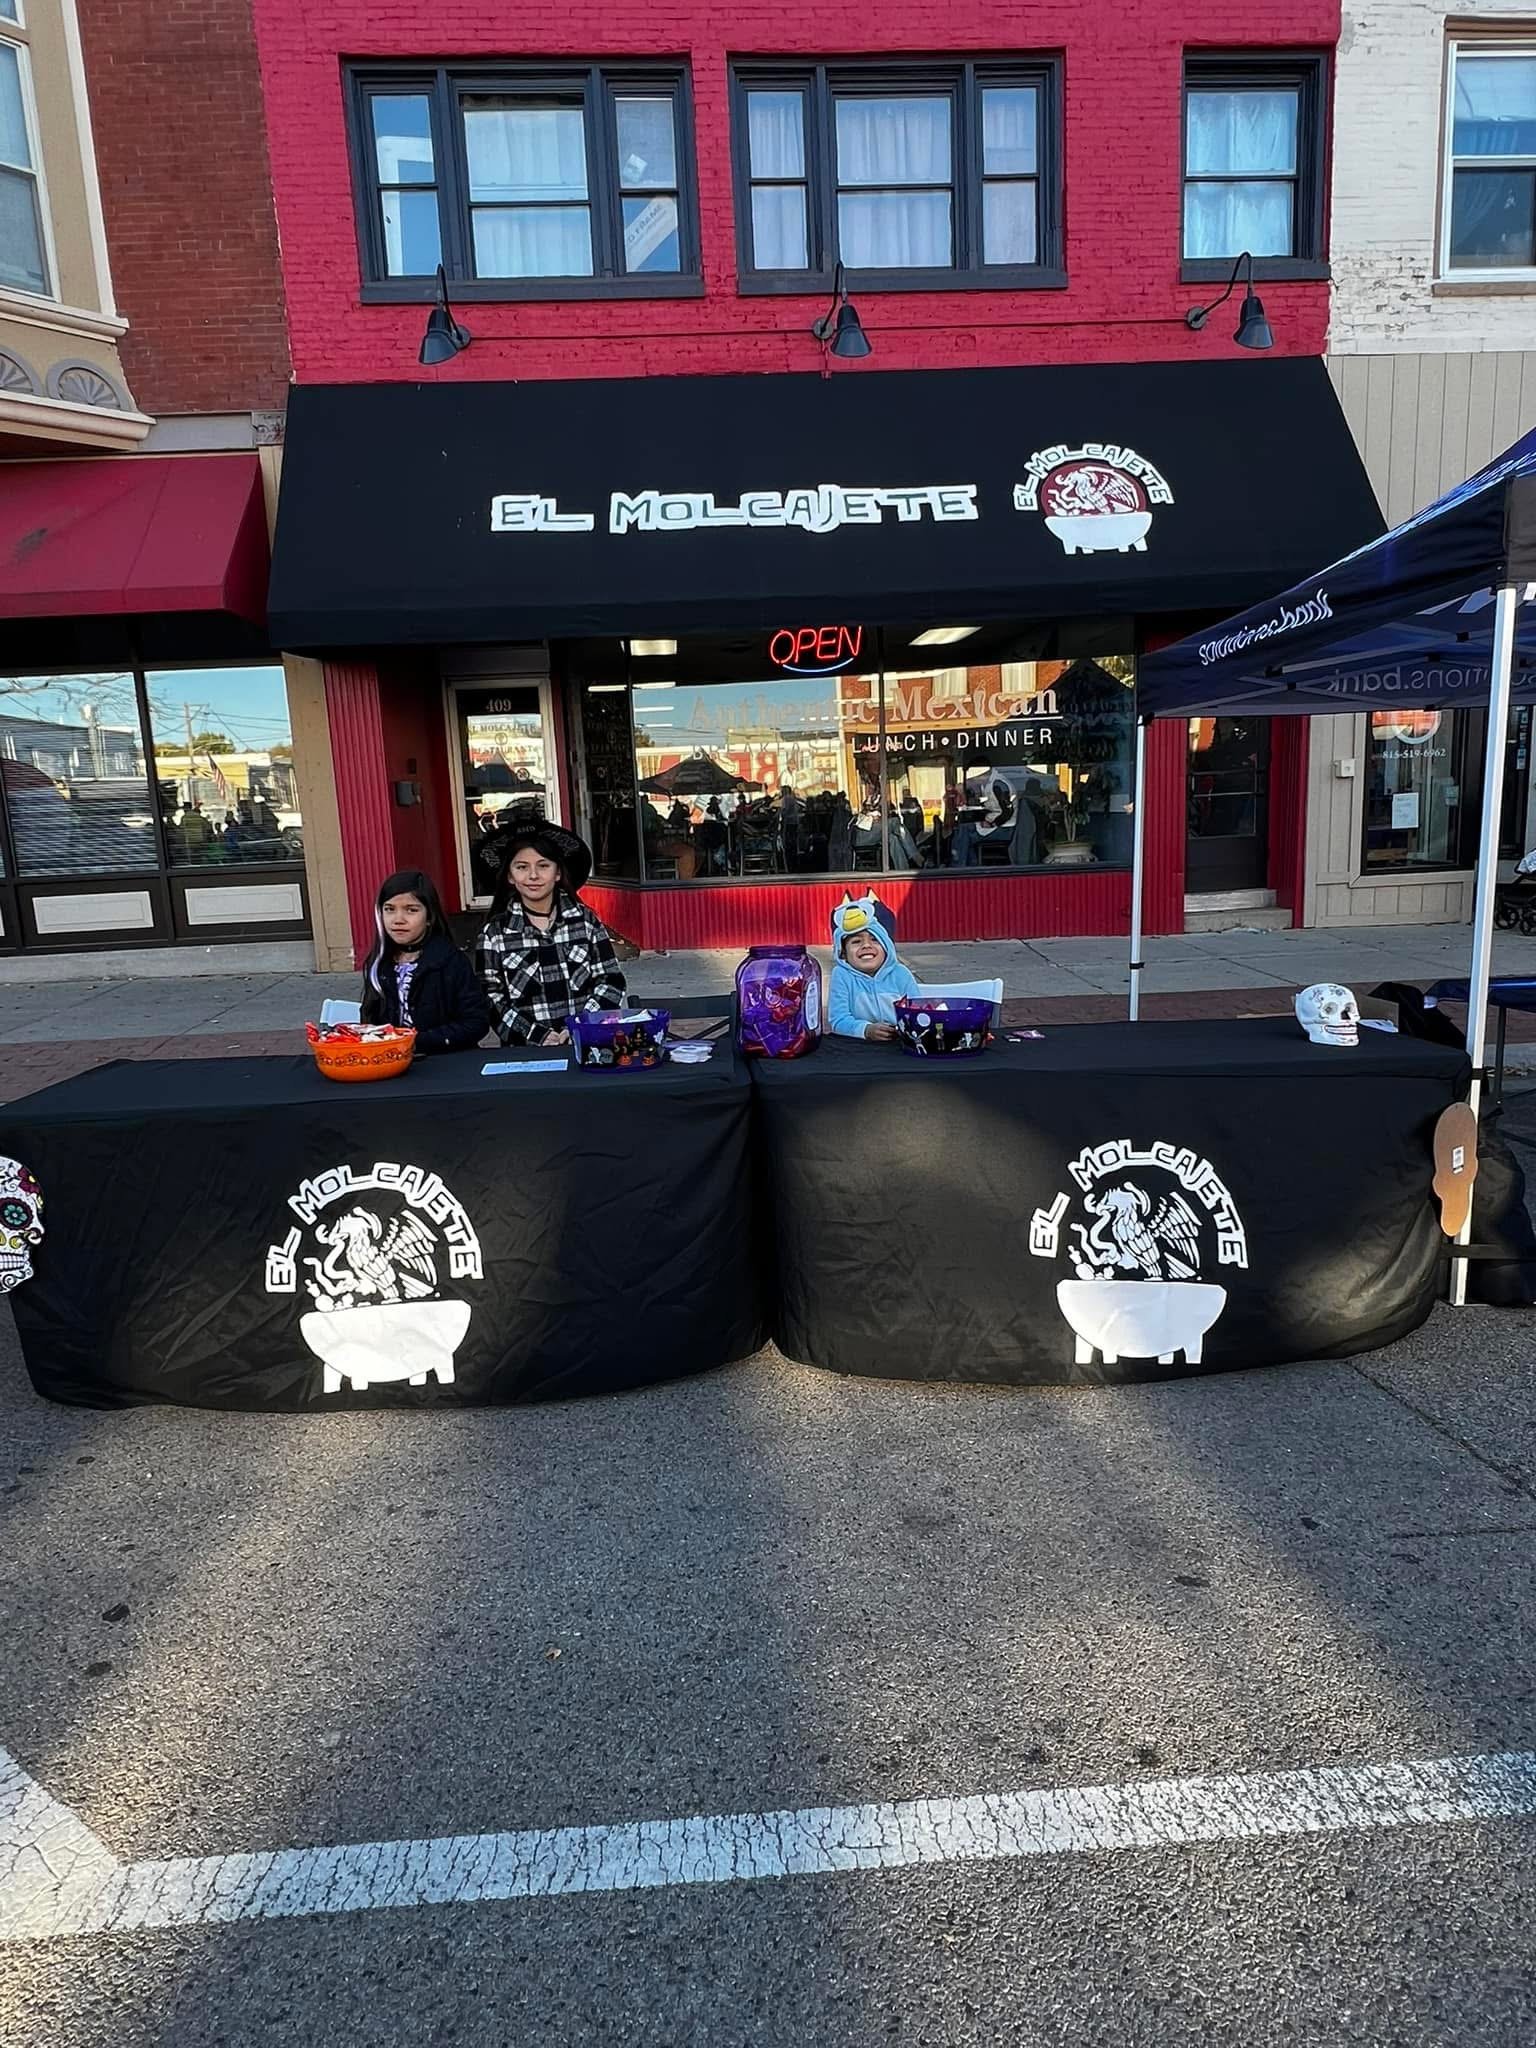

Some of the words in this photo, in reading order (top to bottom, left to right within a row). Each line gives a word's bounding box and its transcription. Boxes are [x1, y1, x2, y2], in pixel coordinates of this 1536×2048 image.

[1013, 474, 1040, 511] EL
[1024, 443, 1175, 504] MOLCAJETE
[491, 494, 594, 532] EL
[609, 484, 979, 534] MOLCAJETE
[770, 625, 862, 664] OPEN
[486, 698, 512, 712] 409
[890, 680, 1060, 725] Mexican
[852, 734, 934, 754] LUNCH
[957, 728, 1053, 749] DINNER
[1029, 1191, 1071, 1258] EL
[1067, 1138, 1249, 1269] MOLCAJETE
[265, 1226, 302, 1293] EL
[287, 1161, 484, 1280] MOLCAJETE
